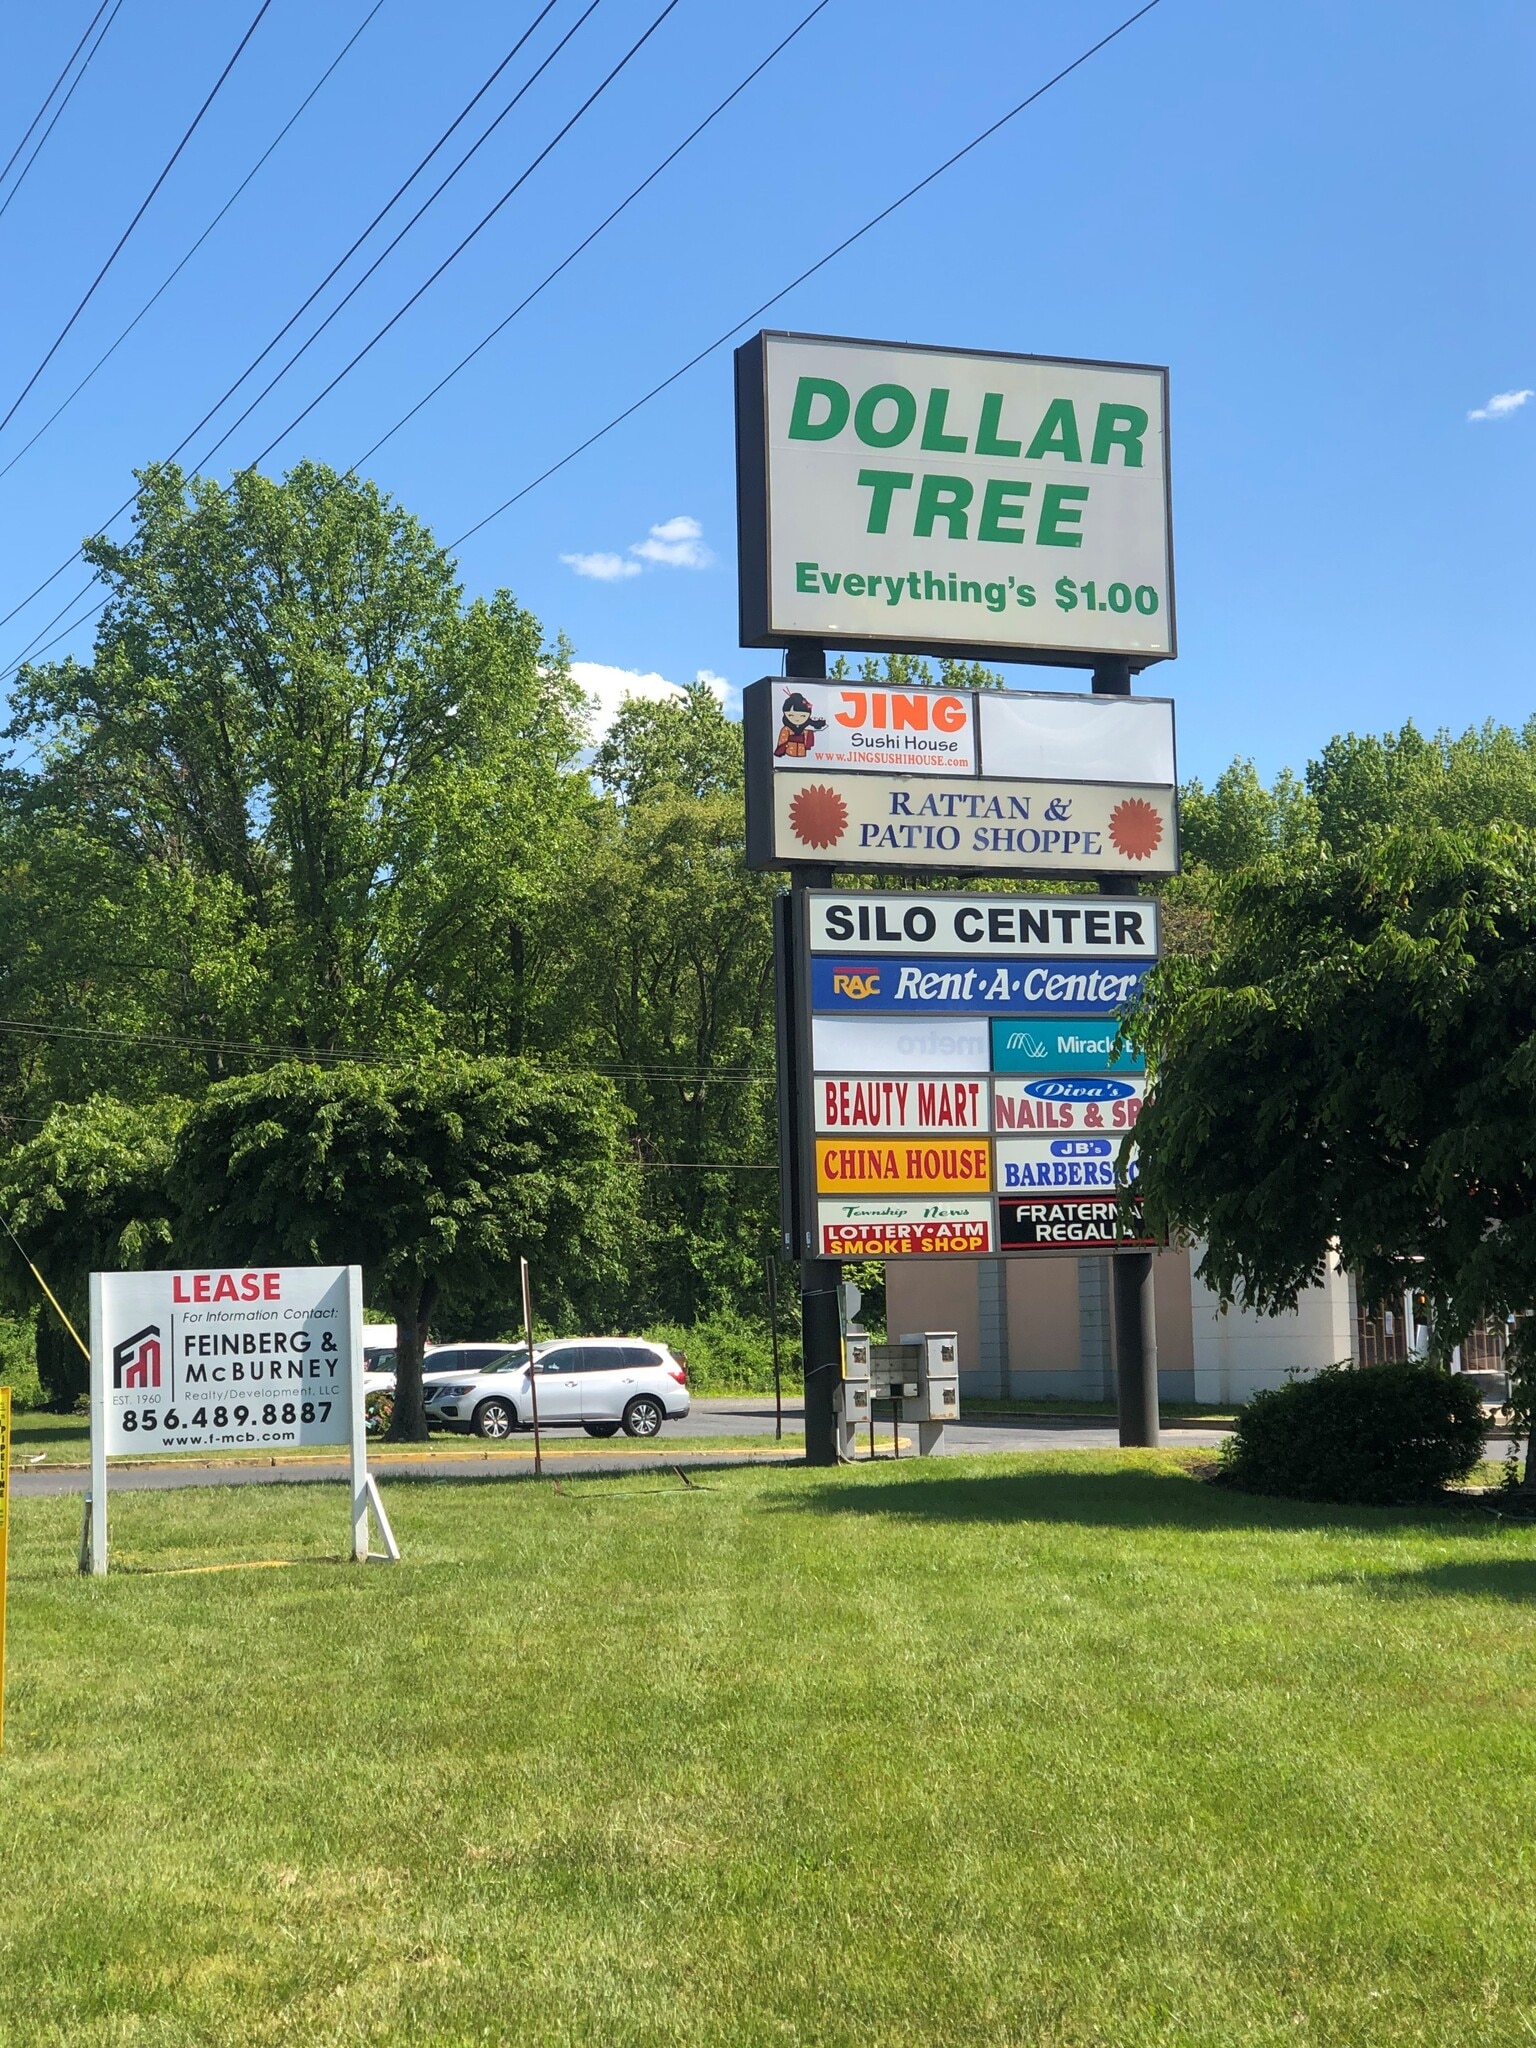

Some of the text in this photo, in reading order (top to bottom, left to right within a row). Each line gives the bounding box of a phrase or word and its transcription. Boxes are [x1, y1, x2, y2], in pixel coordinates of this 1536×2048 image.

[787, 376, 1150, 468] DOLLAR
[856, 468, 1090, 548] TREE
[795, 562, 1160, 616] Everything's $1.00
[834, 691, 968, 733] JING
[851, 732, 958, 752] Sushi House
[815, 751, 969, 768] www.JINGSUSHIHOUSE.com
[888, 791, 1072, 821] RATTAN &
[858, 823, 1103, 856] PATIO SHOPPE
[825, 905, 1146, 946] SILO CENTER
[834, 974, 881, 1000] RAC
[1035, 1082, 1122, 1097] Diva's
[825, 1081, 980, 1128] BEAUTY MART
[995, 1094, 1146, 1129] NAILS & SP
[1060, 1142, 1102, 1155] JB's
[824, 1149, 987, 1181] CHINA HOUSE
[842, 1205, 970, 1219] Township News
[830, 1237, 983, 1255] SMOKE SHOP
[172, 1273, 281, 1303] LEASE
[183, 1308, 339, 1323] For Information Contact:
[184, 1331, 338, 1357] FEINBERG &
[185, 1358, 339, 1383] McBURNEY
[112, 1394, 162, 1406] EST. 1960
[319, 1385, 340, 1396] LLC
[122, 1402, 332, 1432] 856.489.8887
[162, 1430, 295, 1446] www.f-mcb.com
